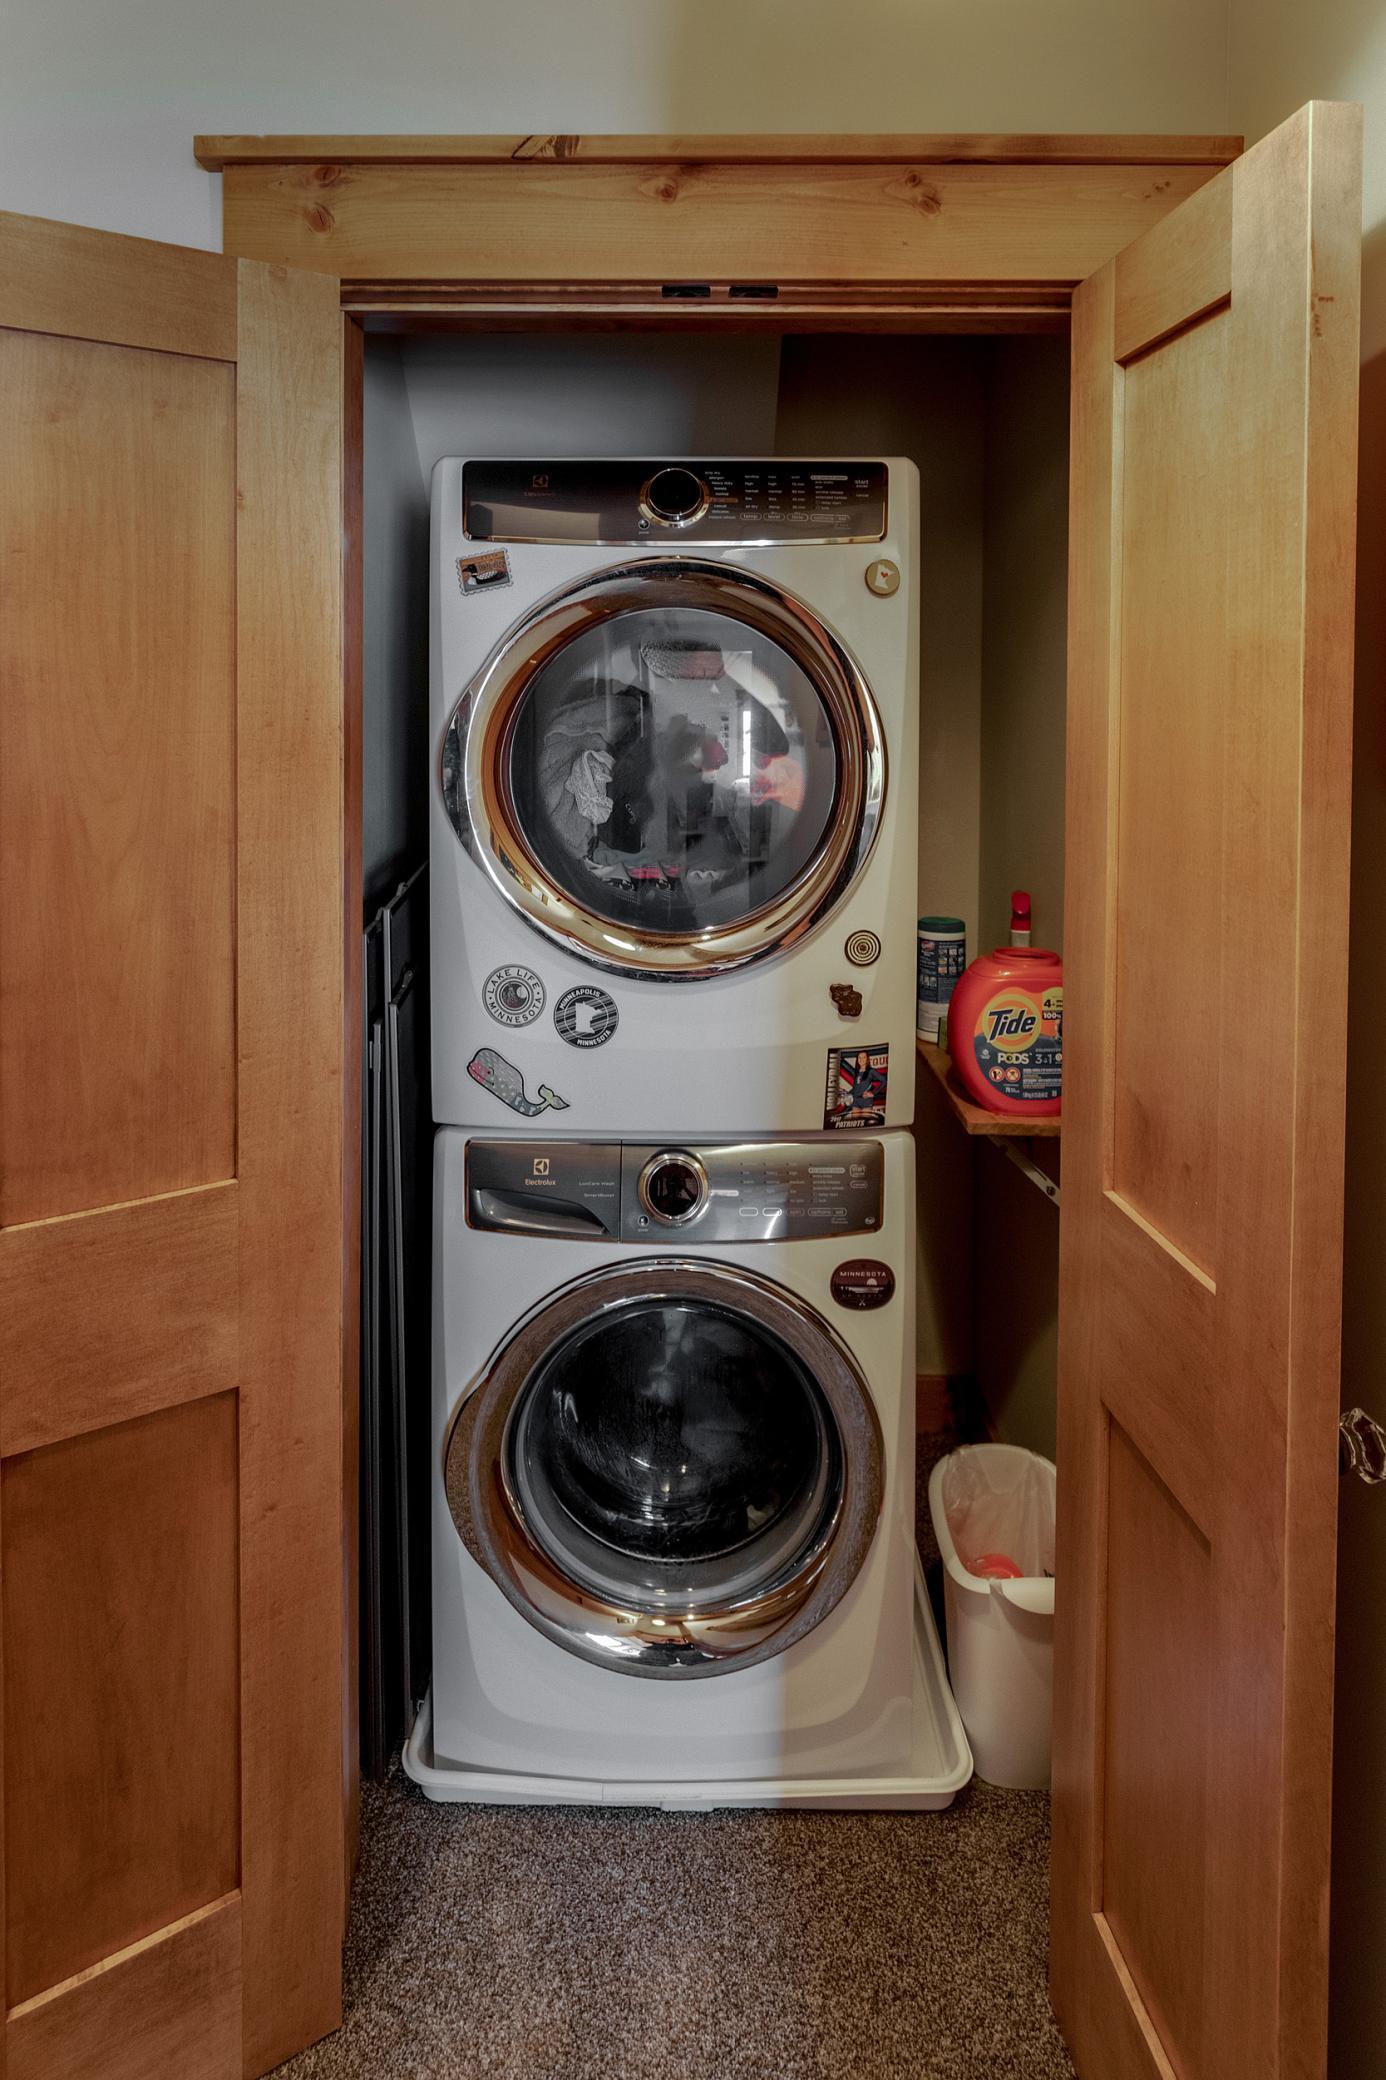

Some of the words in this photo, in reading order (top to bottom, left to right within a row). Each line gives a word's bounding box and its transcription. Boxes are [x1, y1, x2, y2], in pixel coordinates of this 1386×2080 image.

[487, 968, 512, 994] LAKE
[516, 969, 540, 990] LIFE
[559, 988, 601, 1010] MINNEAPOLIS
[488, 998, 542, 1024] MINNESOTA
[988, 1008, 1037, 1042] Tide
[576, 1029, 612, 1047] MINNESOTA
[997, 1053, 1030, 1065] PODS
[835, 1119, 866, 1129] PATRIOTS
[524, 1178, 557, 1186] Electrolux
